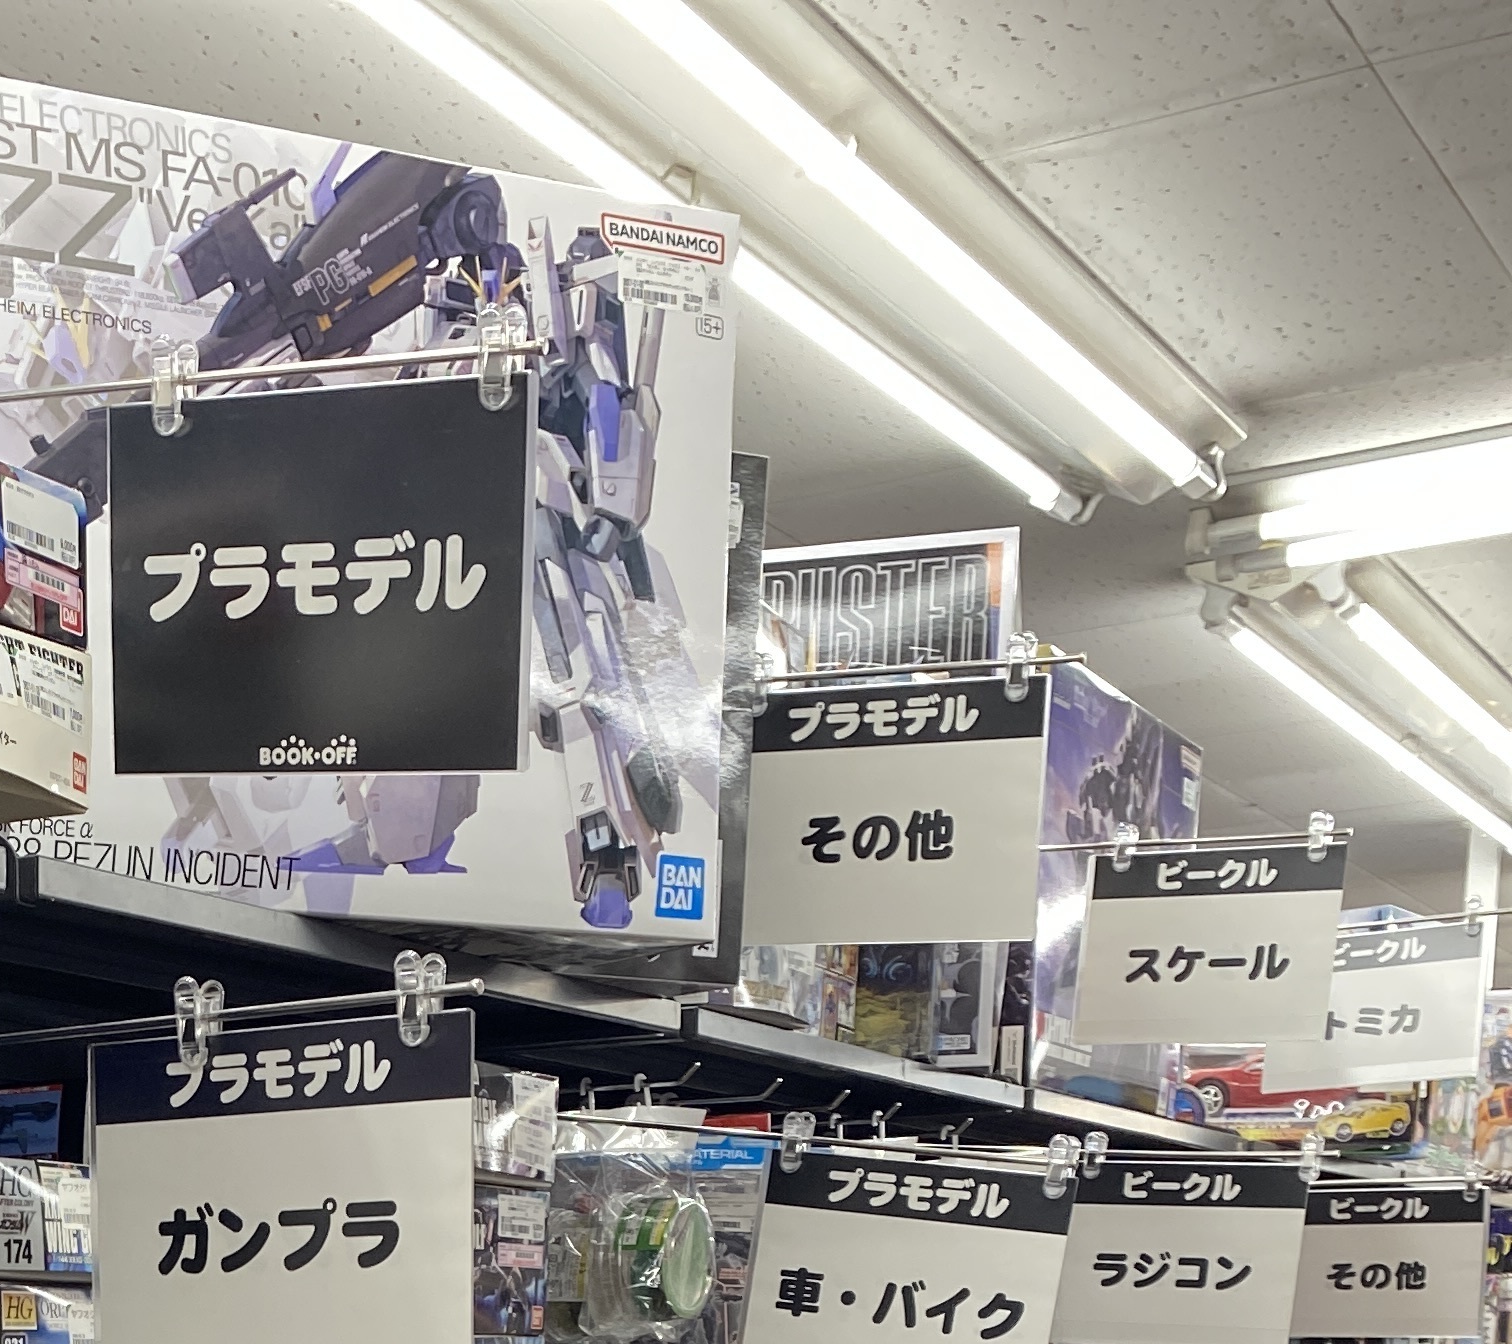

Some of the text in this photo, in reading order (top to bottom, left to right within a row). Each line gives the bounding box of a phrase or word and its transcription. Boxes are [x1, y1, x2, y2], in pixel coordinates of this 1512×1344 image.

[66, 133, 148, 182] MS
[608, 221, 719, 255] BANDAI NAMCO
[42, 306, 152, 334] ELECTRONICS
[143, 529, 487, 623] プラモデル
[789, 694, 978, 740] プラモデル
[802, 809, 954, 863] その他
[165, 847, 299, 891] INCIDENT
[661, 863, 702, 887] BAN
[1157, 861, 1277, 888] ビークル
[662, 889, 701, 911] DAI
[1127, 944, 1289, 983] スケール
[166, 1041, 391, 1107] プラモデル
[829, 1170, 1009, 1220] プラモデル
[1123, 1174, 1240, 1202] ビークル
[1329, 1197, 1428, 1220] ビークル
[3, 1239, 33, 1264] 174
[158, 1199, 400, 1274] ガンプラ
[1092, 1254, 1252, 1290] ラジコン
[1327, 1262, 1426, 1290] その他
[775, 1267, 1024, 1340] 車・バイク
